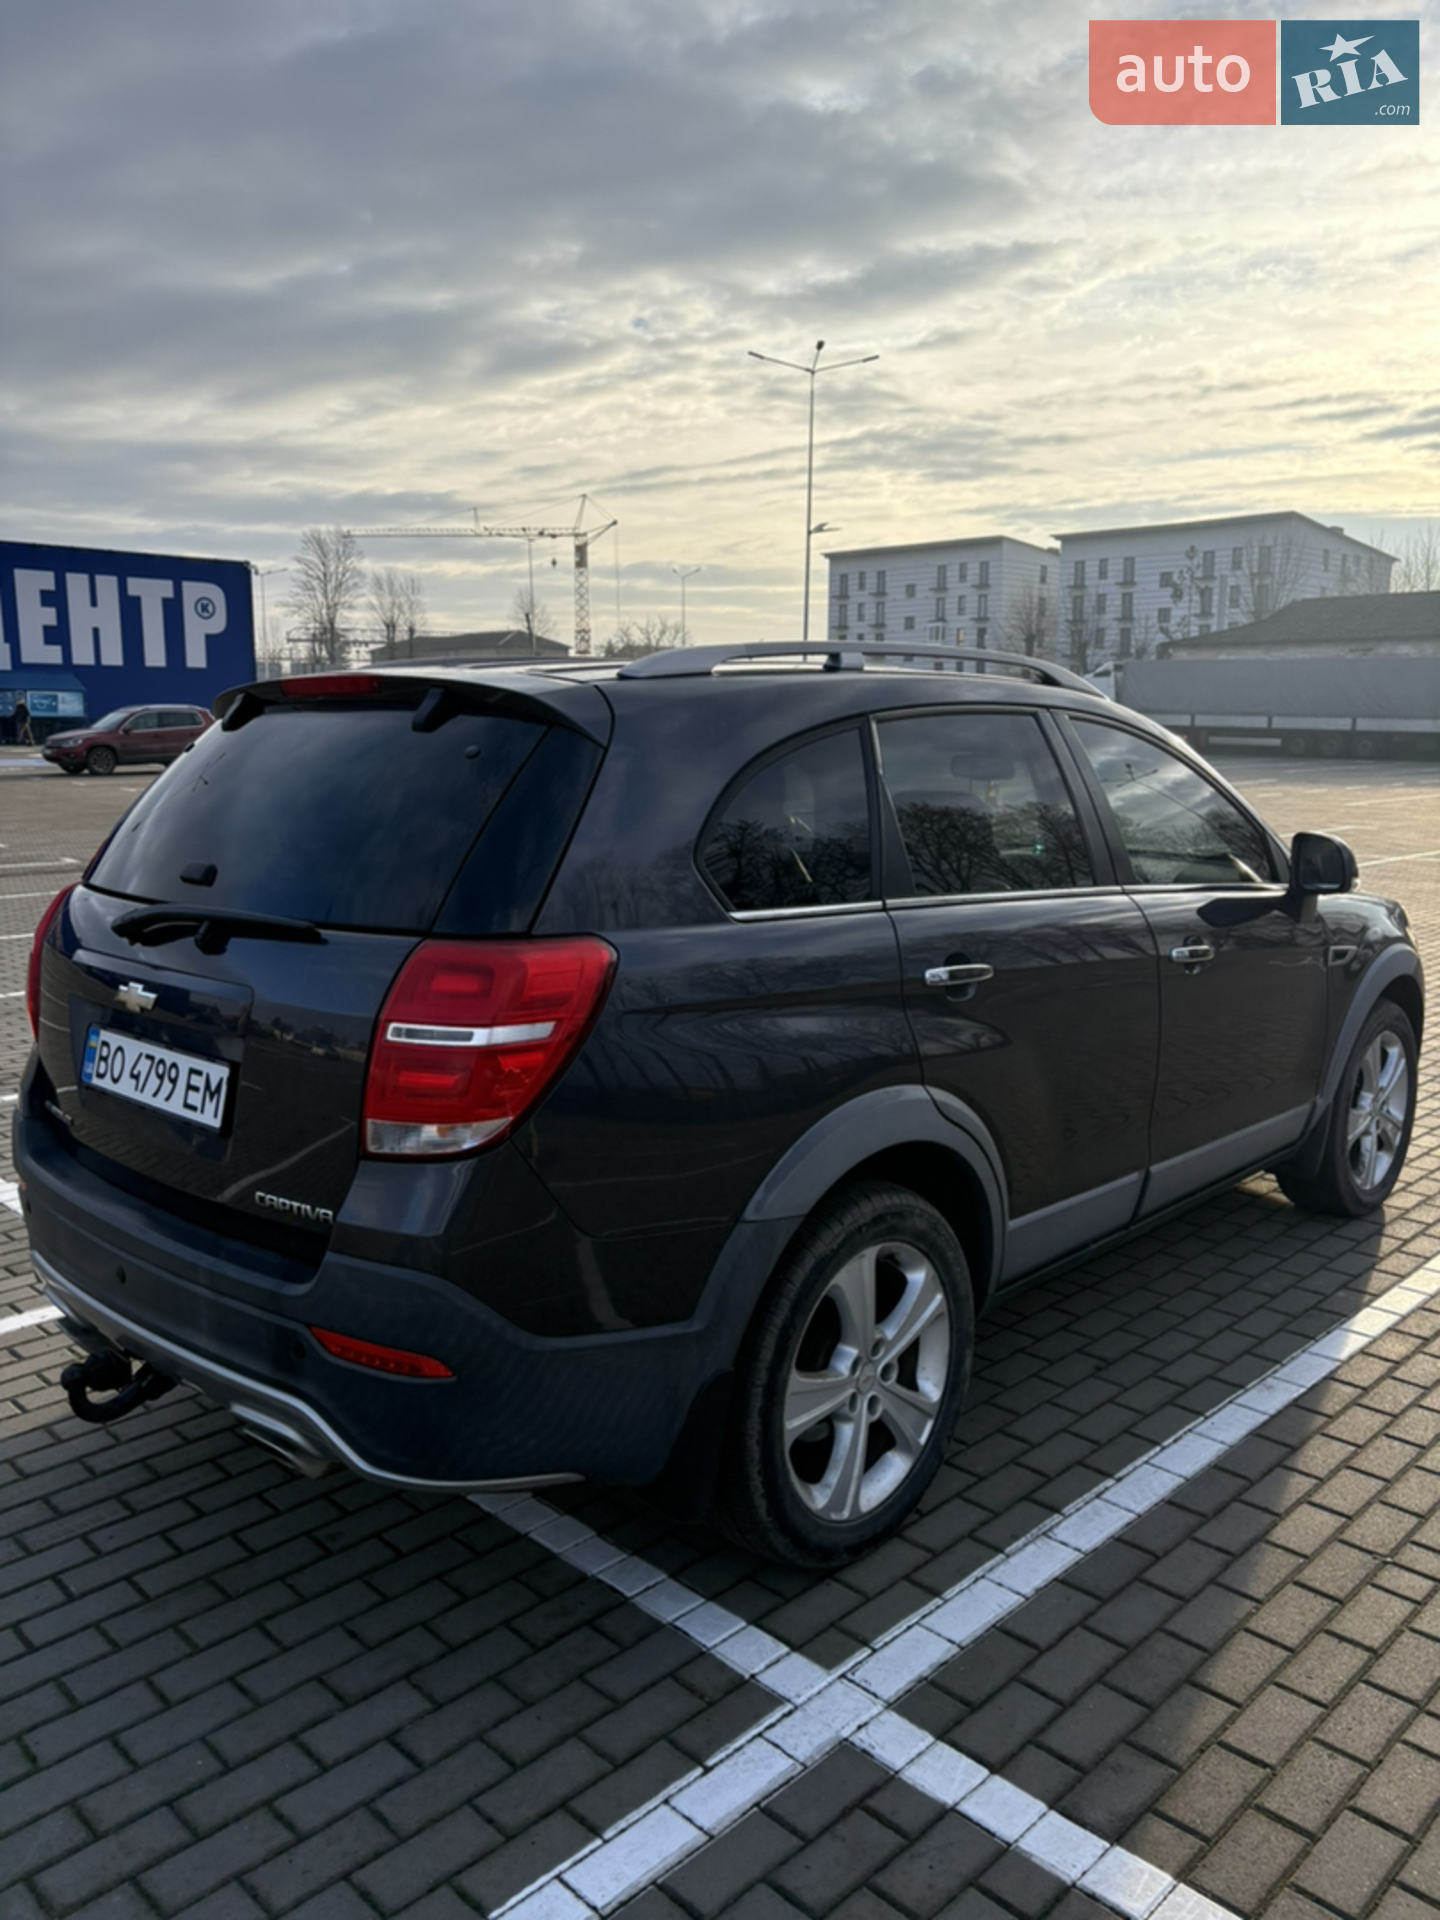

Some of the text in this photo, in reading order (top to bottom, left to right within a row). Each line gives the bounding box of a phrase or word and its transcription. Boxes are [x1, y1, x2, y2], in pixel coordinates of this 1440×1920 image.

[0, 568, 228, 671] ЕНТР
[129, 1052, 180, 1103] 4799
[255, 1191, 333, 1224] CAPTIVA
